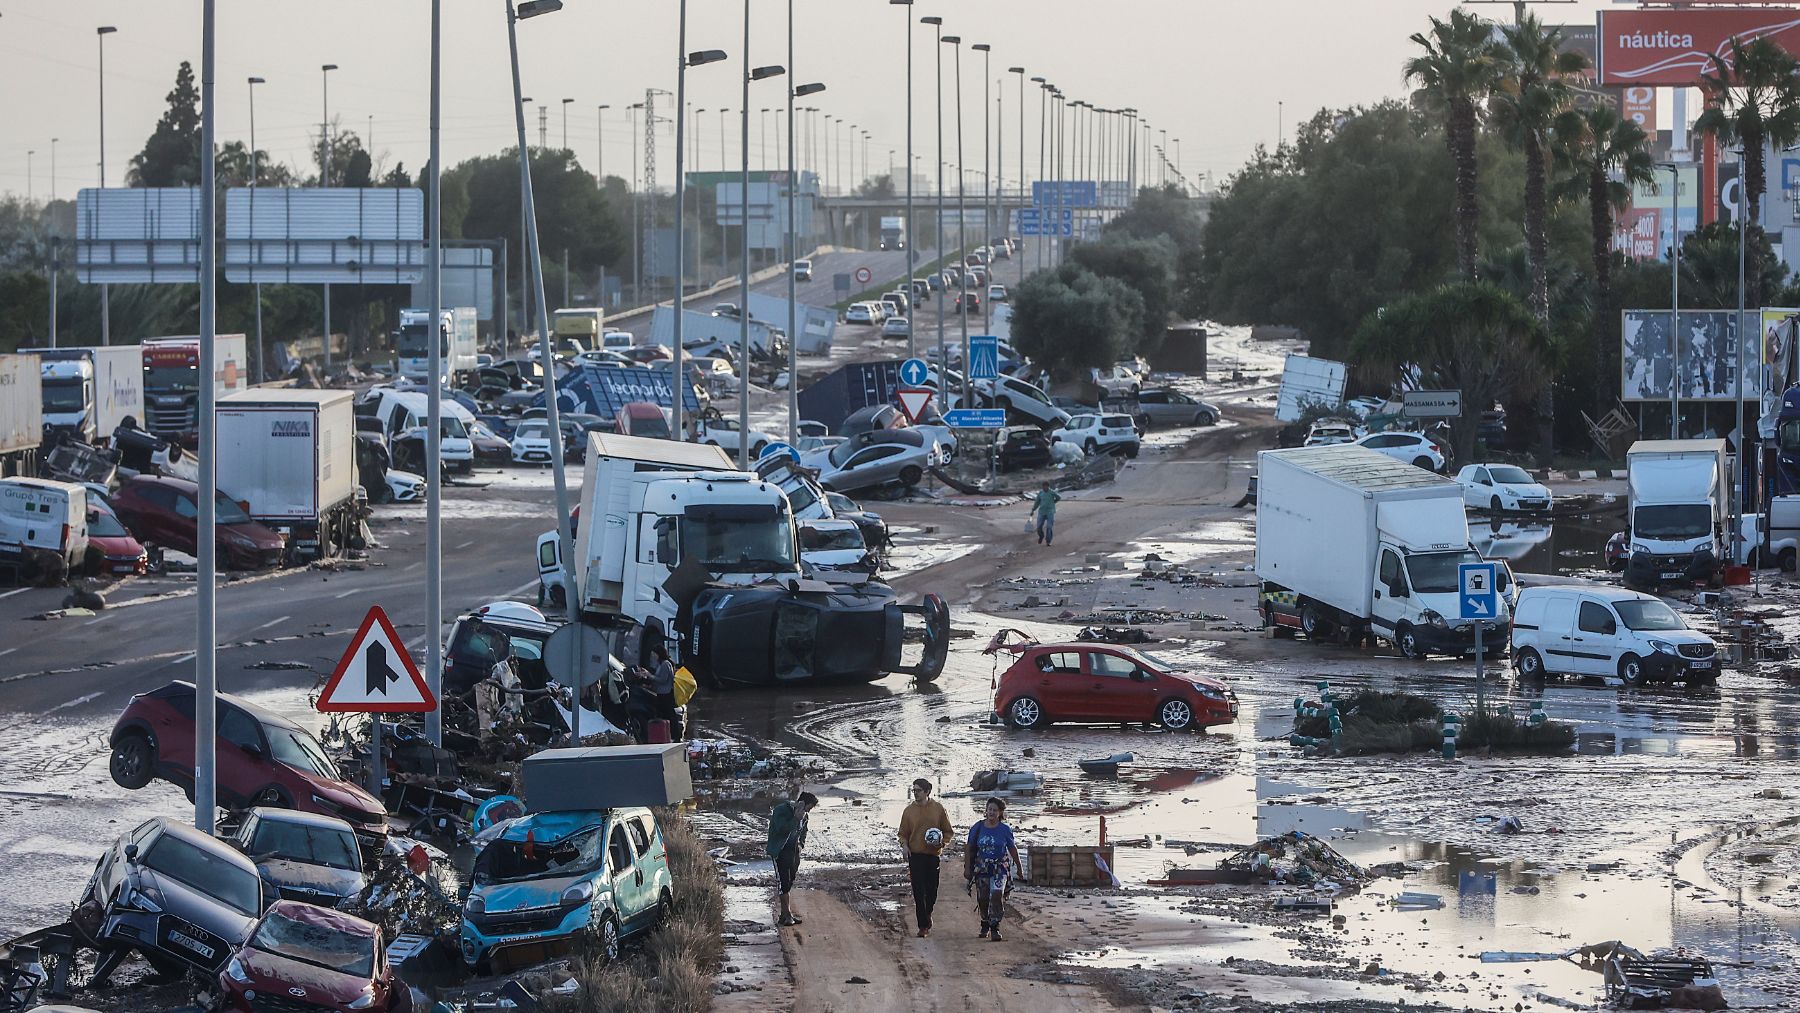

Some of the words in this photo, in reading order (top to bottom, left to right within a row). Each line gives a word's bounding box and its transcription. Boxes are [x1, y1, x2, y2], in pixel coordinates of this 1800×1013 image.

[1619, 30, 1693, 48] náutica
[271, 420, 310, 432] NIKA
[5, 489, 34, 500] Grupo
[39, 494, 58, 503] Tres
[174, 933, 196, 948] 2705
